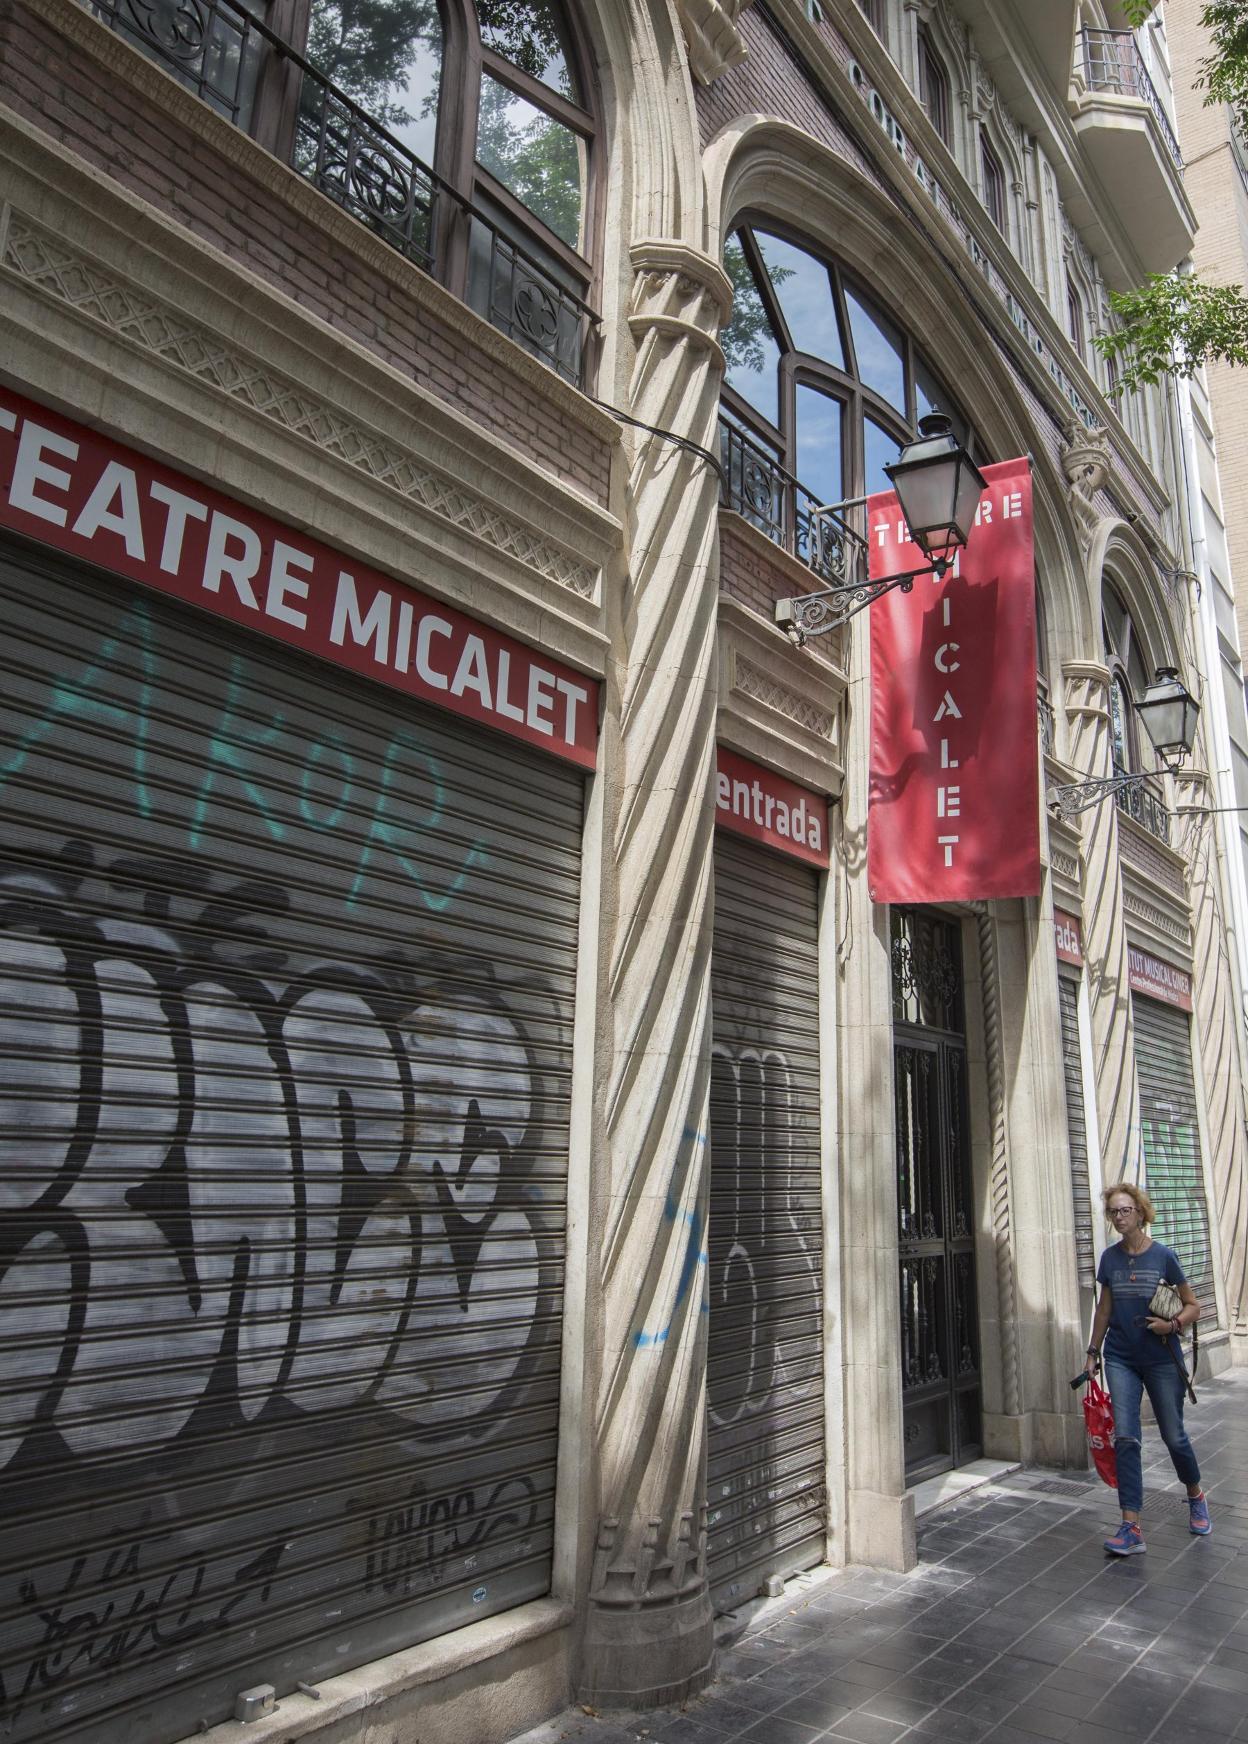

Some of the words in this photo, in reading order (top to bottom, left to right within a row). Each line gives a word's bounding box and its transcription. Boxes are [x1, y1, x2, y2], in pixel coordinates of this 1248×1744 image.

[873, 492, 1022, 547] TERE
[0, 406, 315, 631] EATRE
[329, 570, 588, 747] MICALET
[716, 771, 822, 852] entrada
